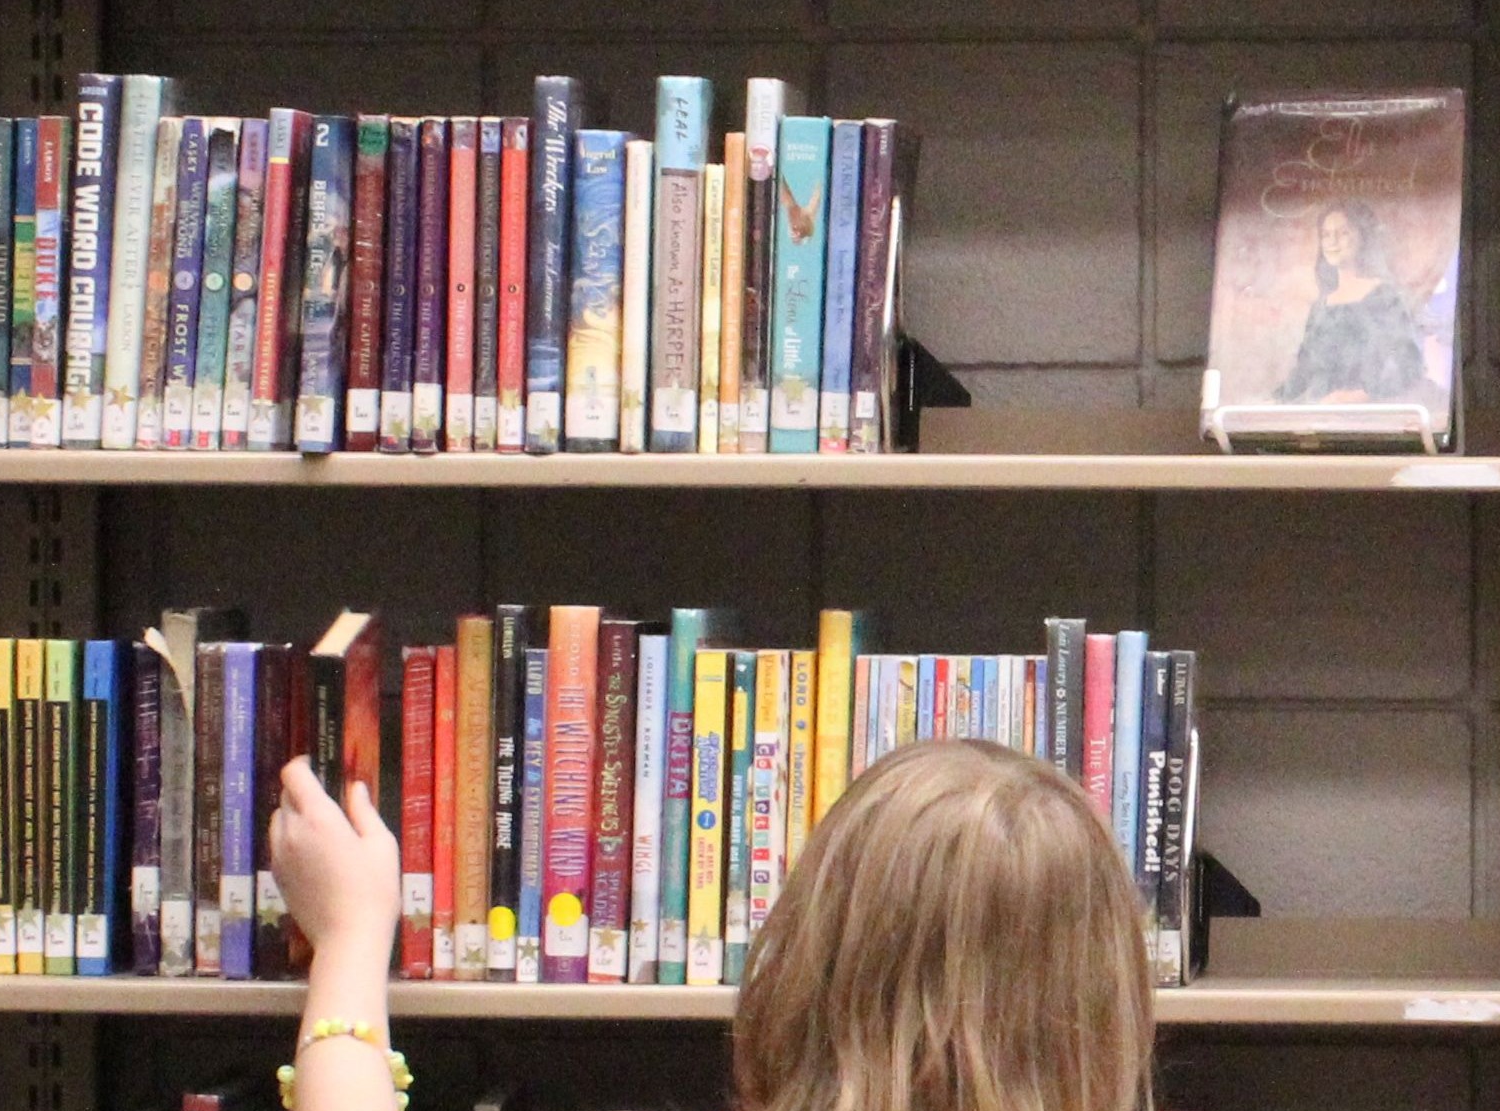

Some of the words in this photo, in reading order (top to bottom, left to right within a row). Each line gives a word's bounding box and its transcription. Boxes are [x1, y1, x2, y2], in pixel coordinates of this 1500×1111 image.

[79, 102, 103, 176] CODE
[547, 98, 566, 129] The
[545, 139, 566, 214] Wreckers
[671, 183, 688, 214] Also
[75, 185, 100, 270] WORD
[669, 220, 683, 270] Known
[668, 276, 681, 294] As
[174, 304, 188, 355] FROST
[664, 302, 685, 380] HARPER
[794, 661, 807, 705] LORD
[497, 737, 514, 759] THE
[552, 721, 587, 817] WITCHING
[669, 717, 691, 797] DRITA
[497, 765, 514, 803] TILTING
[1166, 758, 1184, 812] DOG
[496, 813, 512, 848] HOUSE
[1144, 751, 1168, 872] Punished!
[552, 827, 587, 876] WIND
[1164, 824, 1182, 881] DAYS
